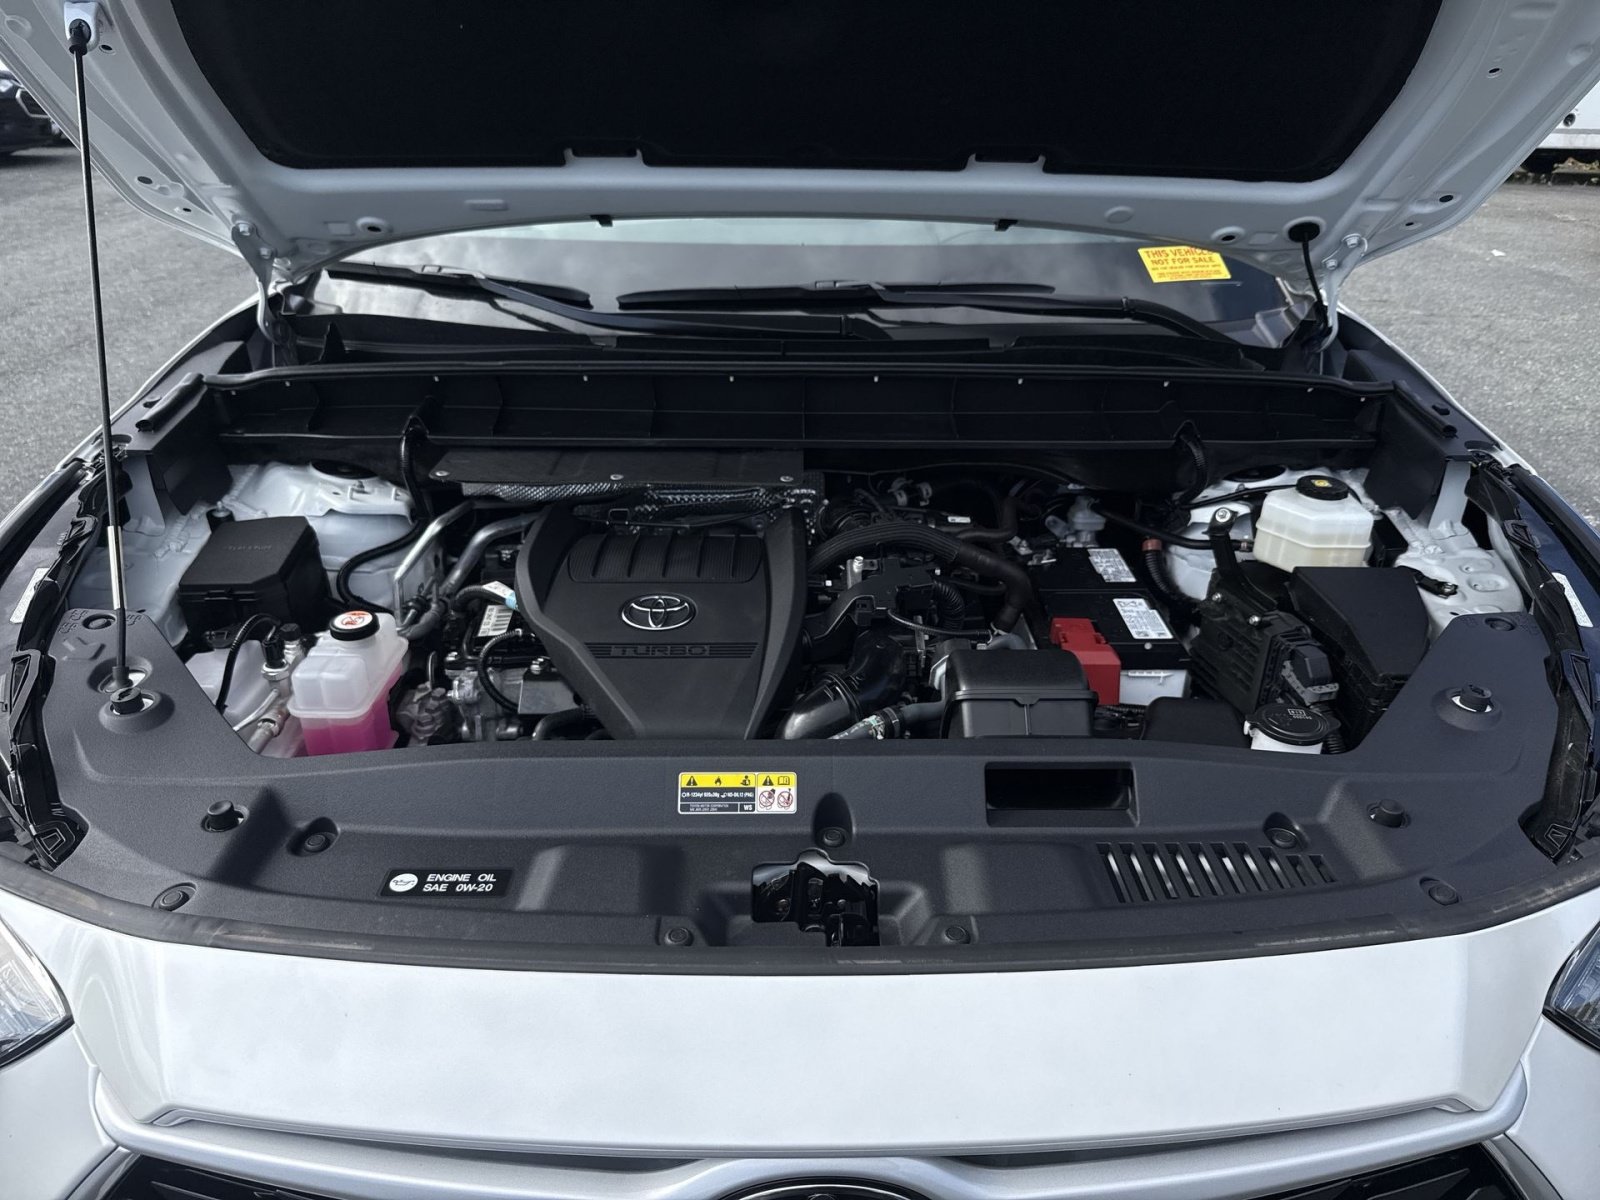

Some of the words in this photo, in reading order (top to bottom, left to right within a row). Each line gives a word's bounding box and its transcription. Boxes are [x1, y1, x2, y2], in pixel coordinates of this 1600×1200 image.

[1144, 249, 1169, 258] THIS
[613, 646, 708, 656] TURBO
[426, 873, 472, 882] ENGINE
[477, 873, 497, 882] OIL
[422, 883, 449, 892] SAE
[455, 883, 494, 892] 0W-20
